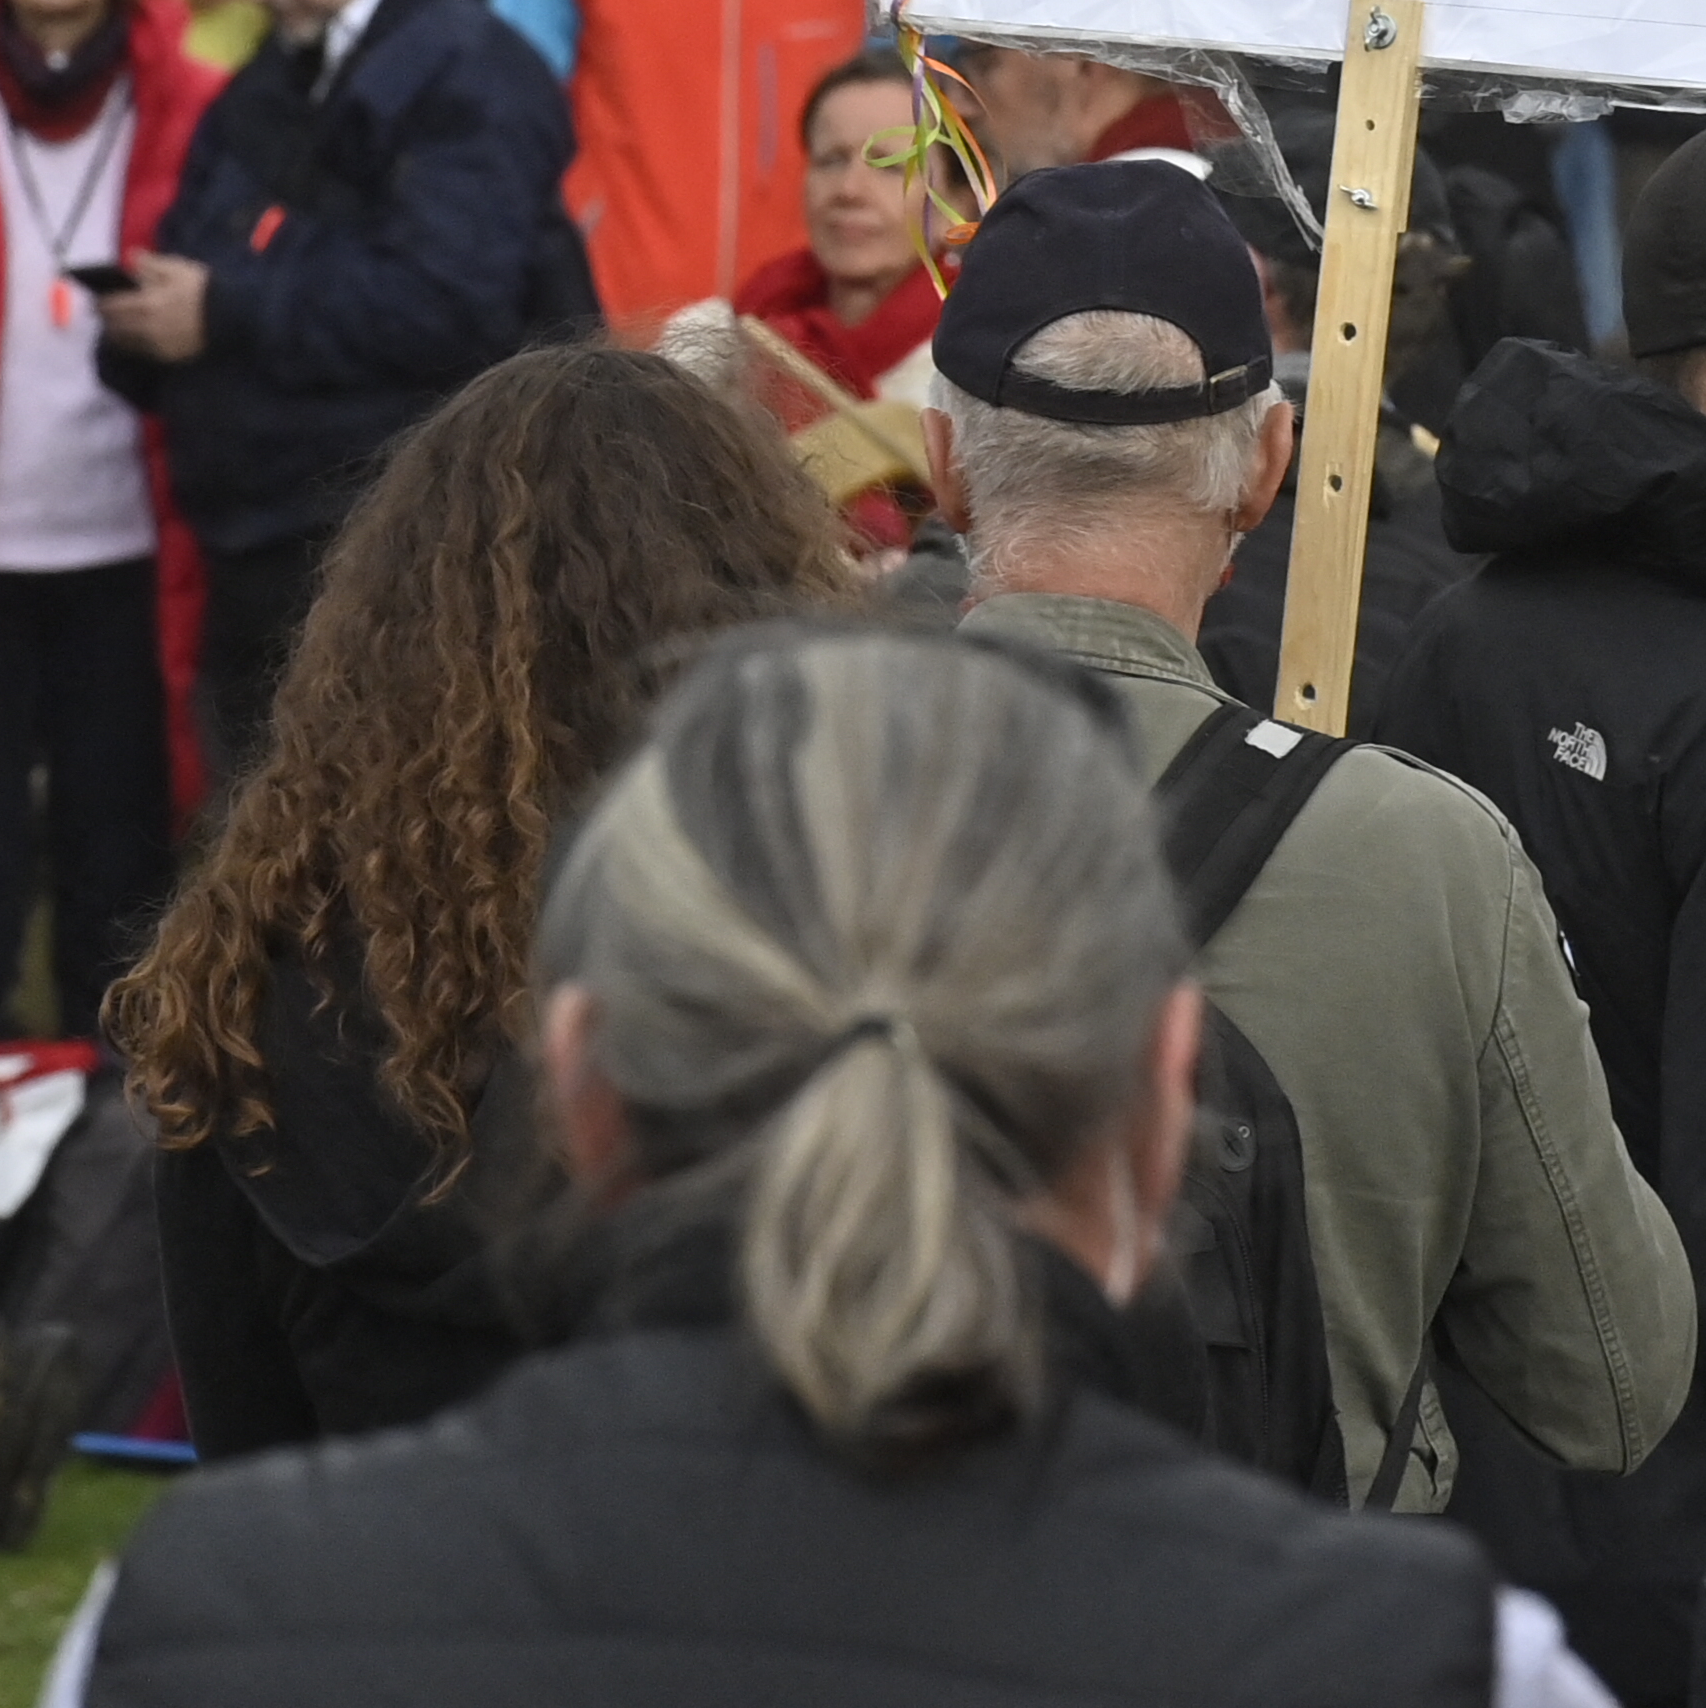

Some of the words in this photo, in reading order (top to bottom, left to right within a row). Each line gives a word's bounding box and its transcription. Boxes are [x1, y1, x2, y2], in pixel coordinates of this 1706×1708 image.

[1547, 726, 1590, 757] NORTH
[1573, 721, 1596, 745] THE
[1552, 744, 1589, 772] FACE
